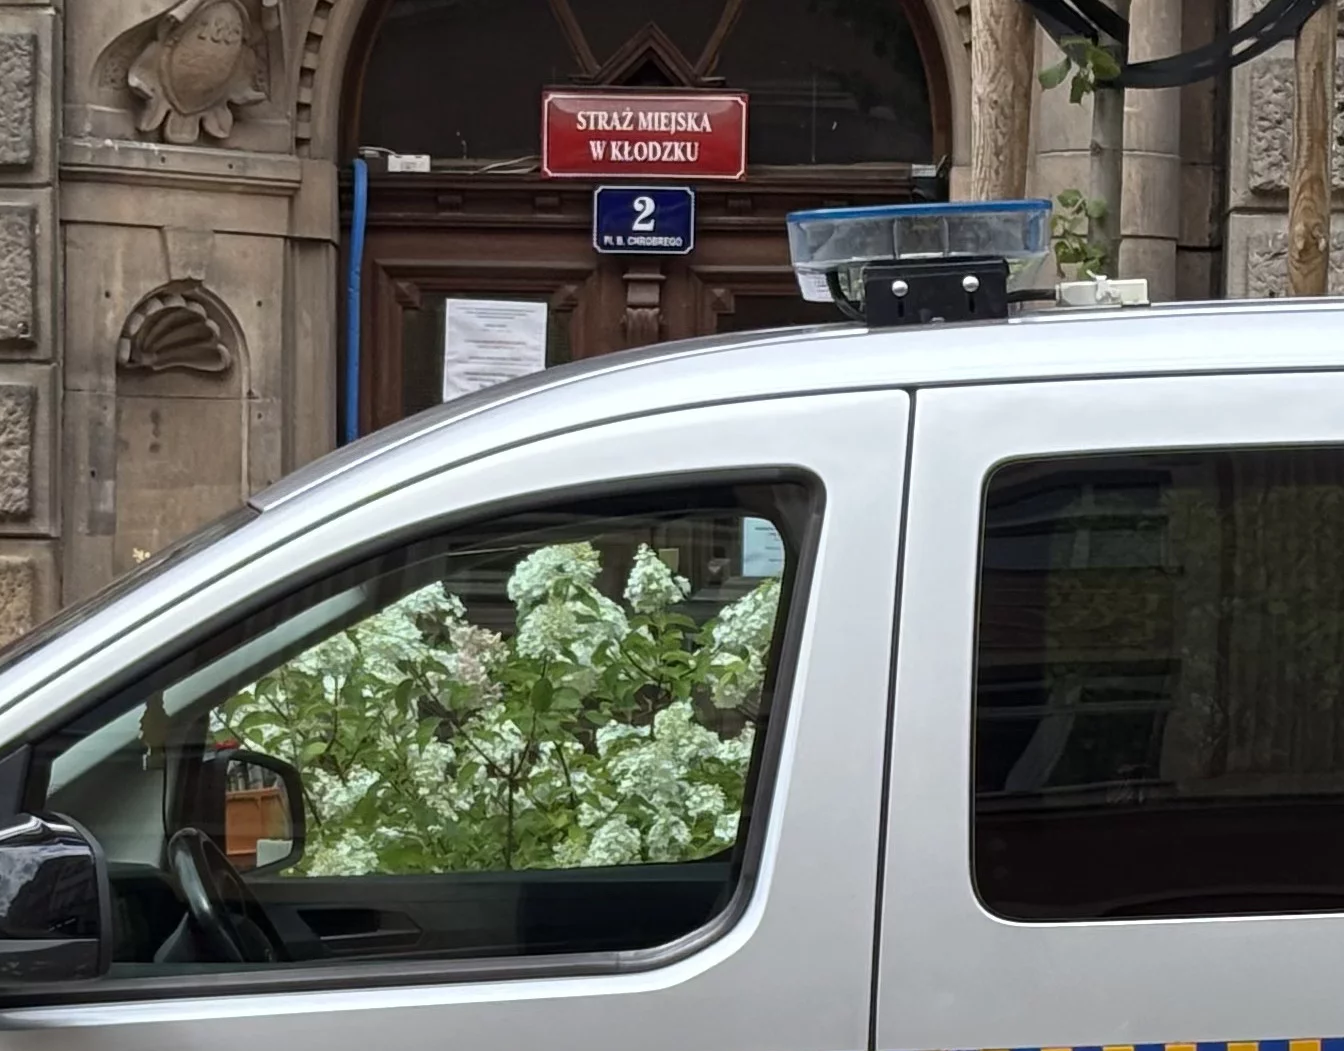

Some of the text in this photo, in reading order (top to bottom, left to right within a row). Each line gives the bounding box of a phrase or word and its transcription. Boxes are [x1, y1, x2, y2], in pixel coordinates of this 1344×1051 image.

[576, 107, 712, 134] STRAŻ MIEJSKA
[589, 140, 699, 163] W KŁODZKU
[632, 196, 655, 231] 2
